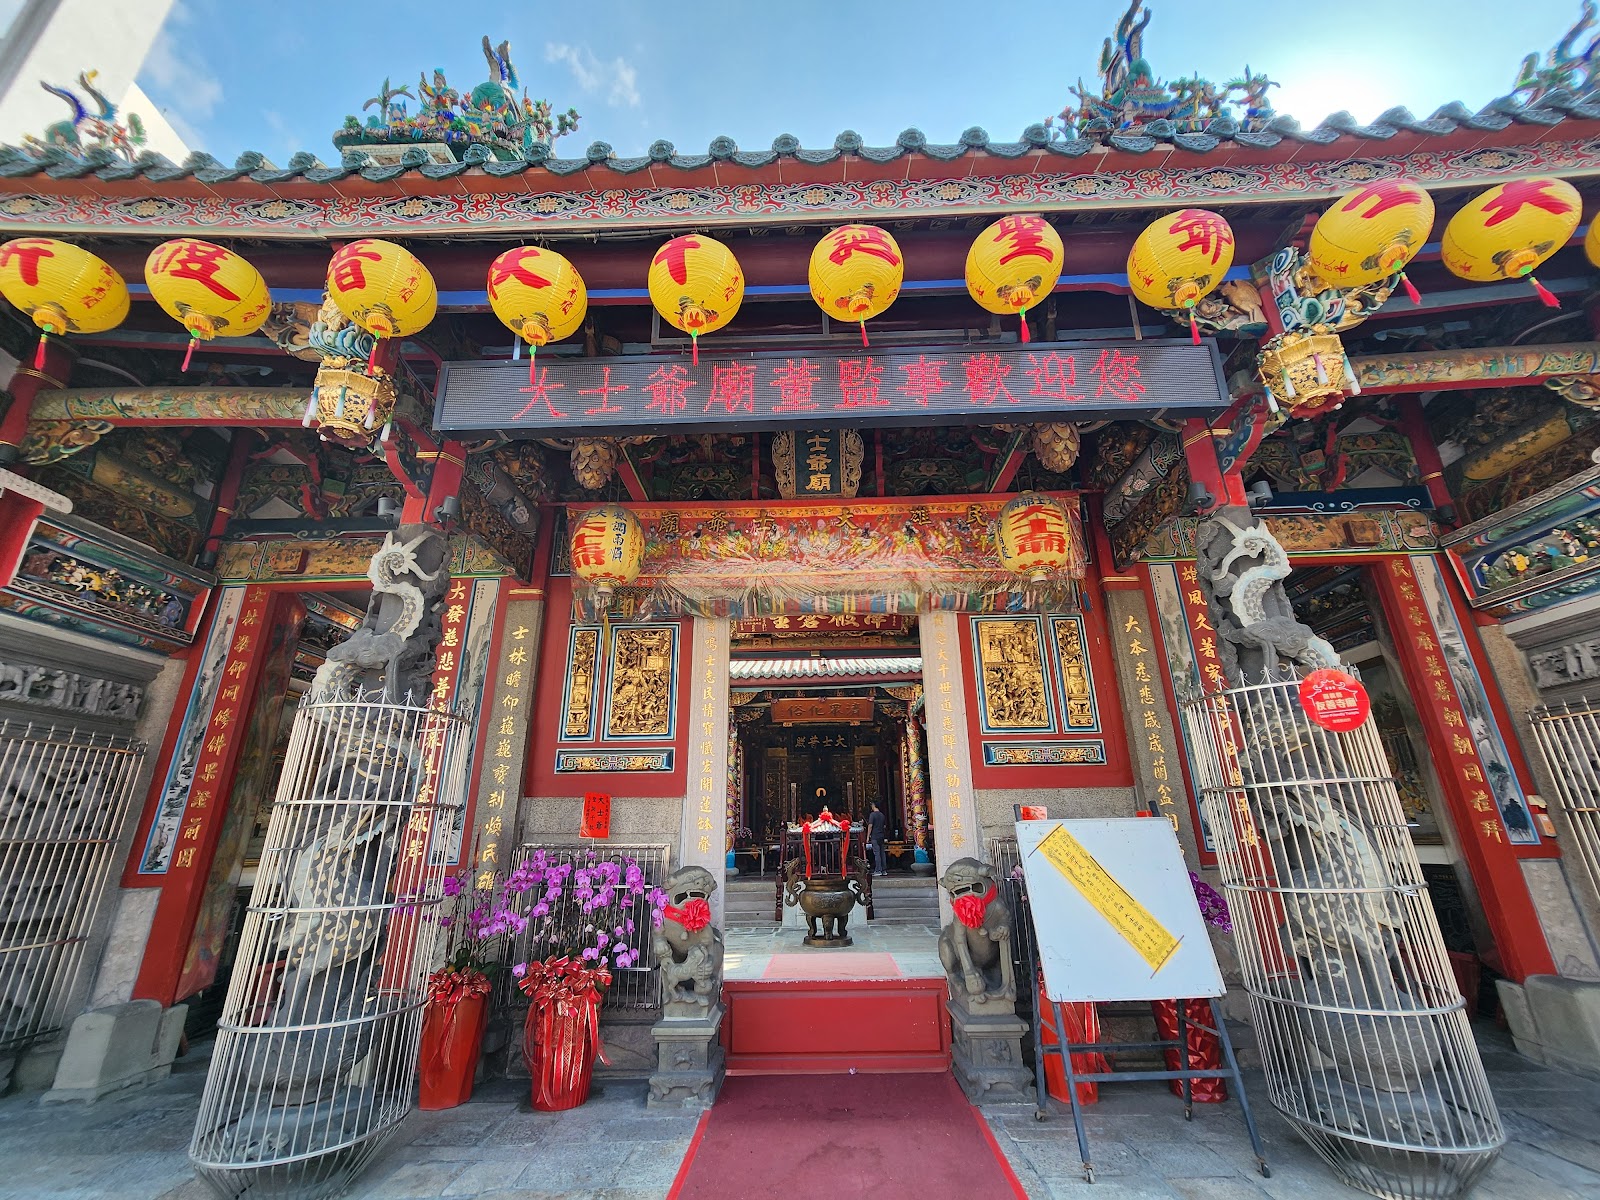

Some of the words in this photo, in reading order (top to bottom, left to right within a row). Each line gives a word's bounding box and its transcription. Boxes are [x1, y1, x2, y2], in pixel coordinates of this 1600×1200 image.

[1480, 179, 1574, 227] 大
[655, 235, 701, 285] 千
[512, 349, 1147, 420] 大士爺廟董監事歡迎您
[806, 428, 831, 491] 士爺廟
[1125, 616, 1184, 855] 大本慈悲歲歲蘭盆
